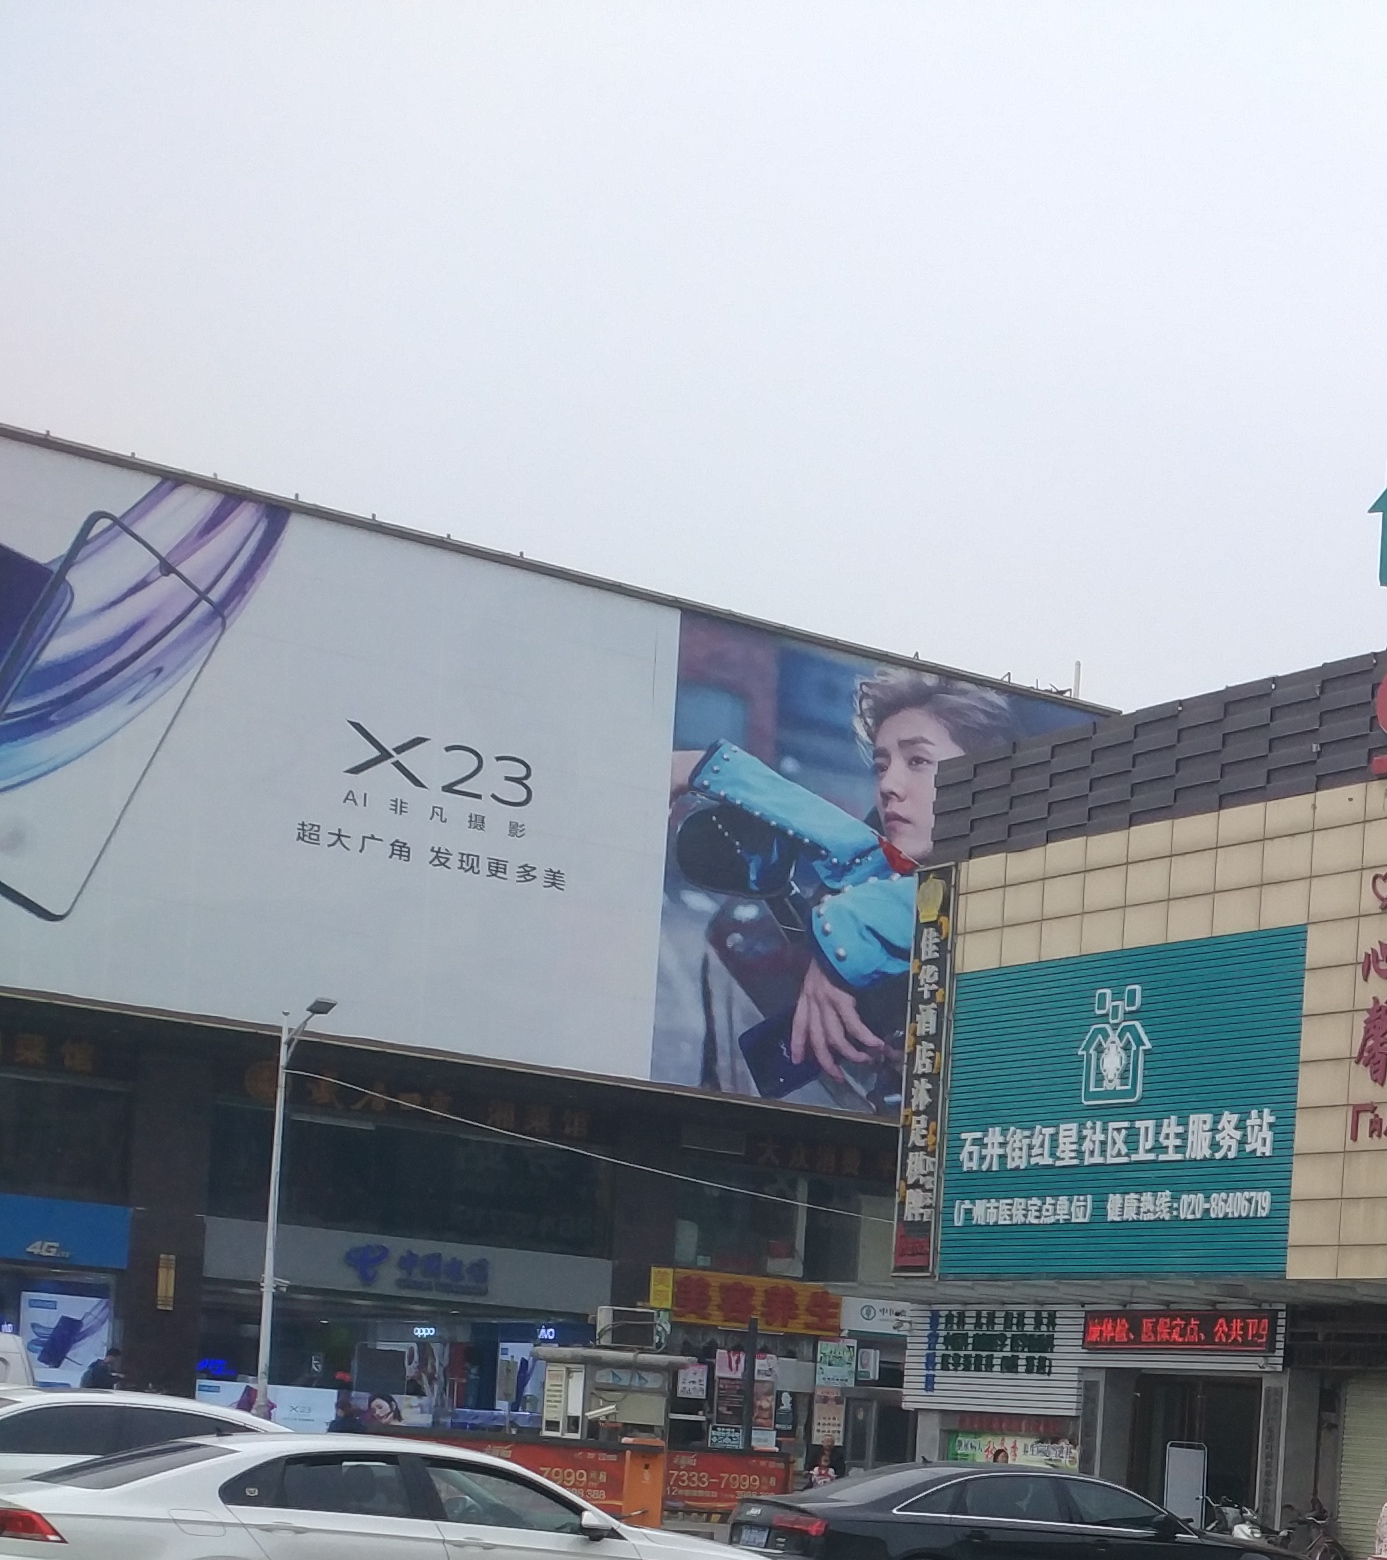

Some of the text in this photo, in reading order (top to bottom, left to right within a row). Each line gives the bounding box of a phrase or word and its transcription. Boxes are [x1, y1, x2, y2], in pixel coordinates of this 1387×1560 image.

[342, 719, 534, 809] X23
[342, 790, 527, 840] AI 非凡摄影
[295, 820, 566, 892] 超大广角 发现更多美
[959, 1108, 1277, 1172] 石井街红星社区卫生服务站
